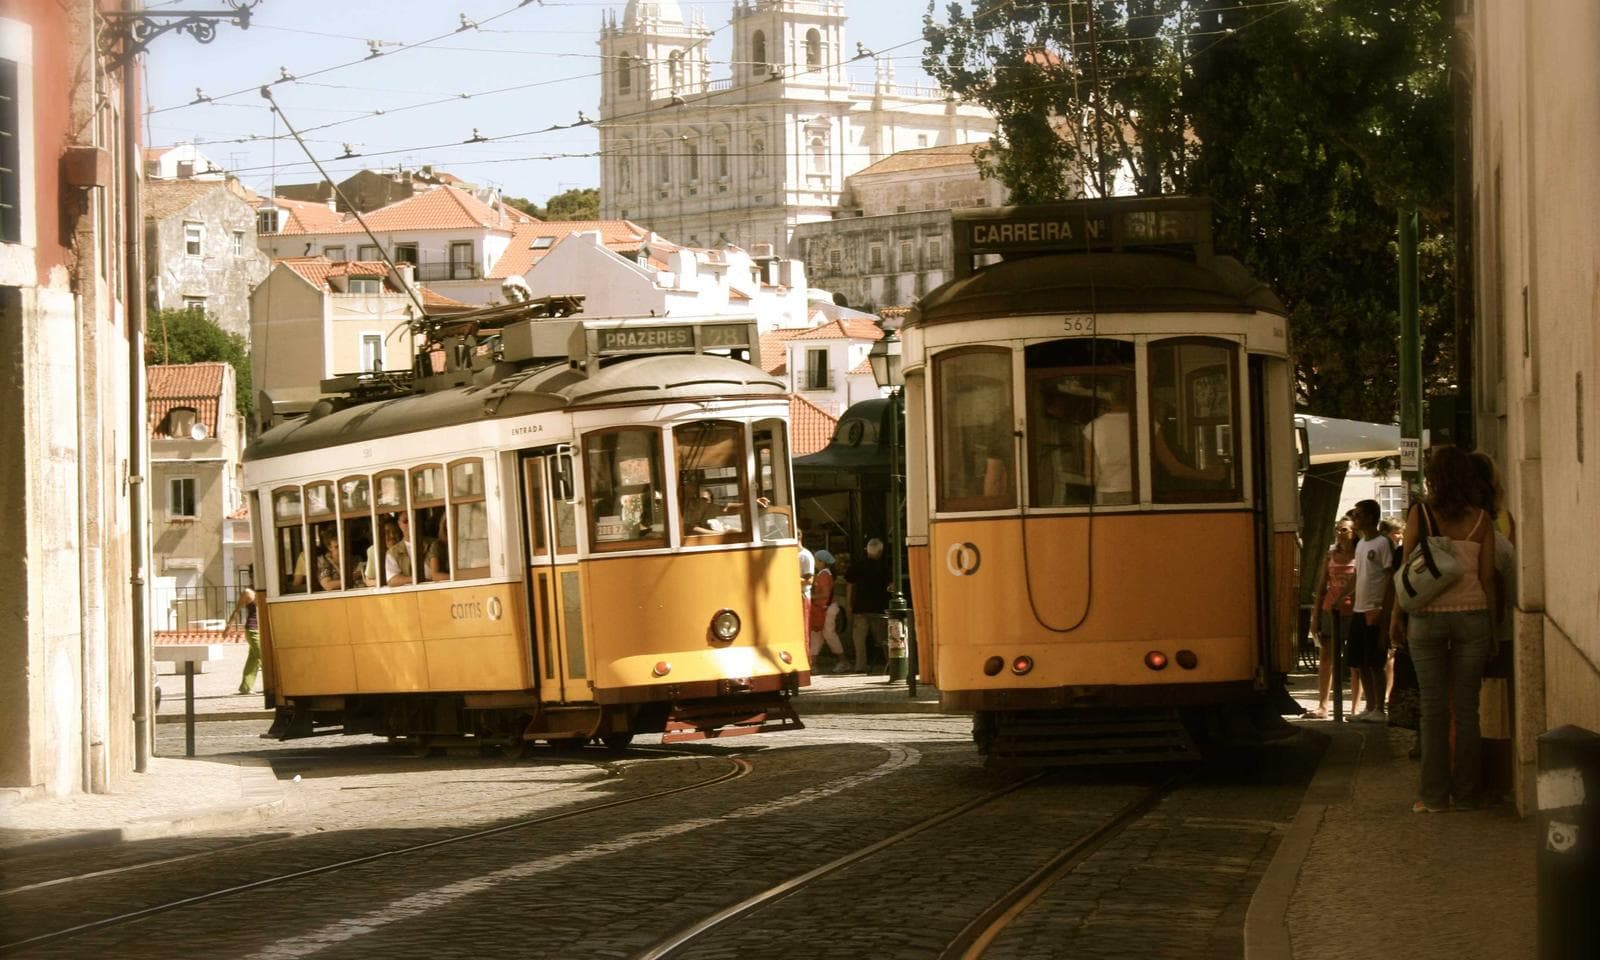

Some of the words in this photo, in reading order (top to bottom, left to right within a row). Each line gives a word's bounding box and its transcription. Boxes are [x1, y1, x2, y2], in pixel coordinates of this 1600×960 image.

[973, 222, 1073, 244] CARREIRA
[1064, 317, 1093, 331] 562
[606, 330, 687, 347] PRAZERES
[708, 328, 738, 346] 28
[511, 424, 543, 436] ENTRADA
[450, 602, 481, 620] carris
